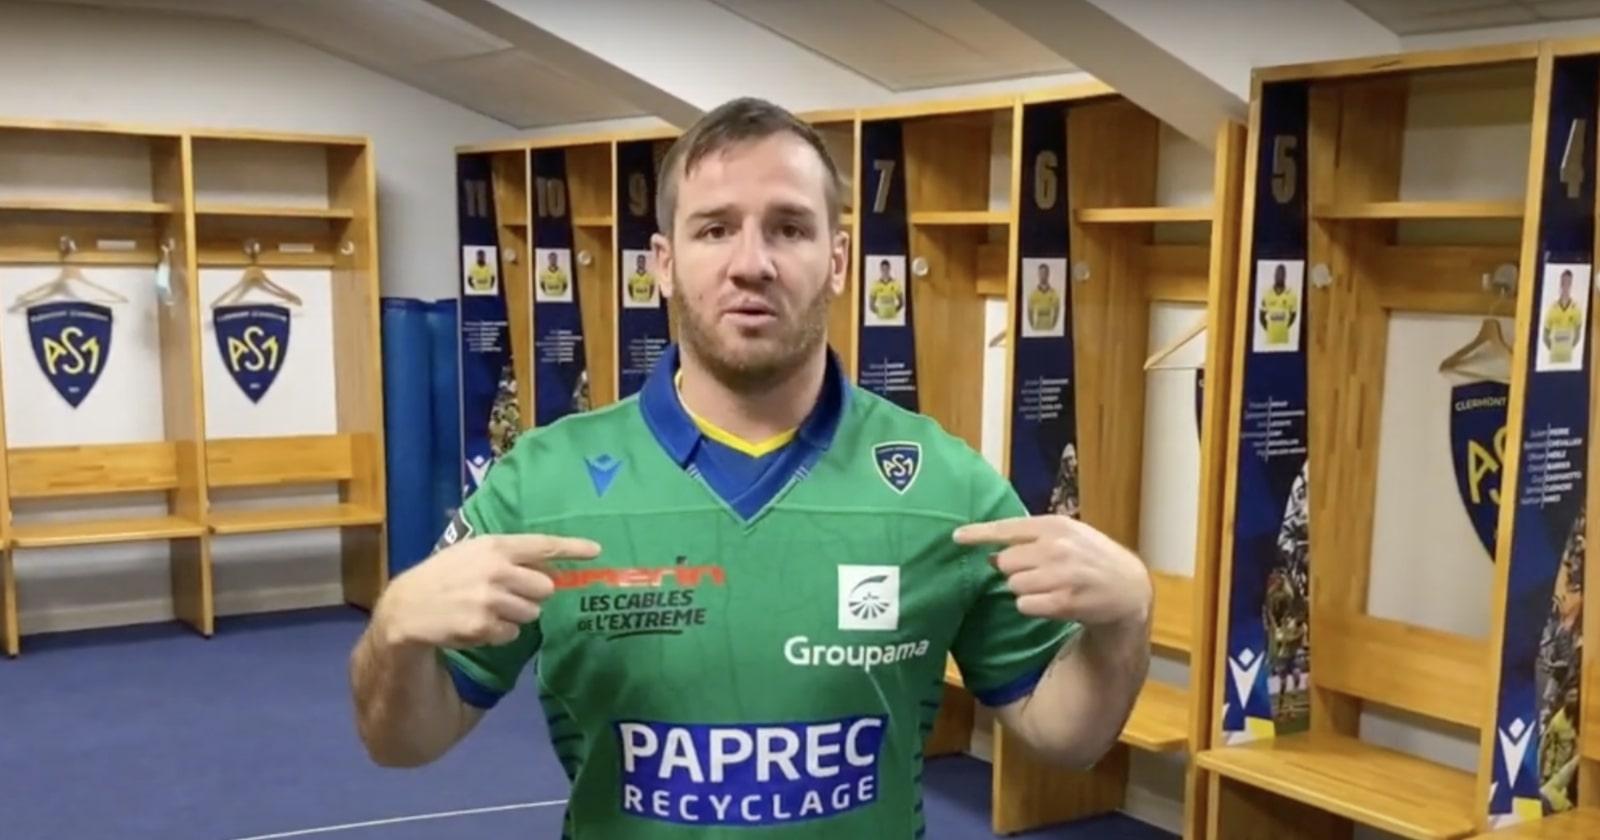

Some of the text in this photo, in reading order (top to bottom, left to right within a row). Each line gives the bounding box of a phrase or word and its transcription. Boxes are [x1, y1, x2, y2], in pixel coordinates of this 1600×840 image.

[1035, 150, 1058, 210] 6
[1271, 135, 1297, 203] 5
[1560, 118, 1586, 198] 4
[464, 179, 487, 217] 11
[536, 177, 566, 217] 10
[629, 173, 648, 215] 9
[873, 160, 896, 213] 7
[580, 589, 694, 612] LES CABLES
[595, 608, 706, 631] L'EXTREME
[784, 635, 930, 673] Groupama
[619, 718, 882, 783] PAPREC
[623, 775, 875, 821] RECYCLAGE
